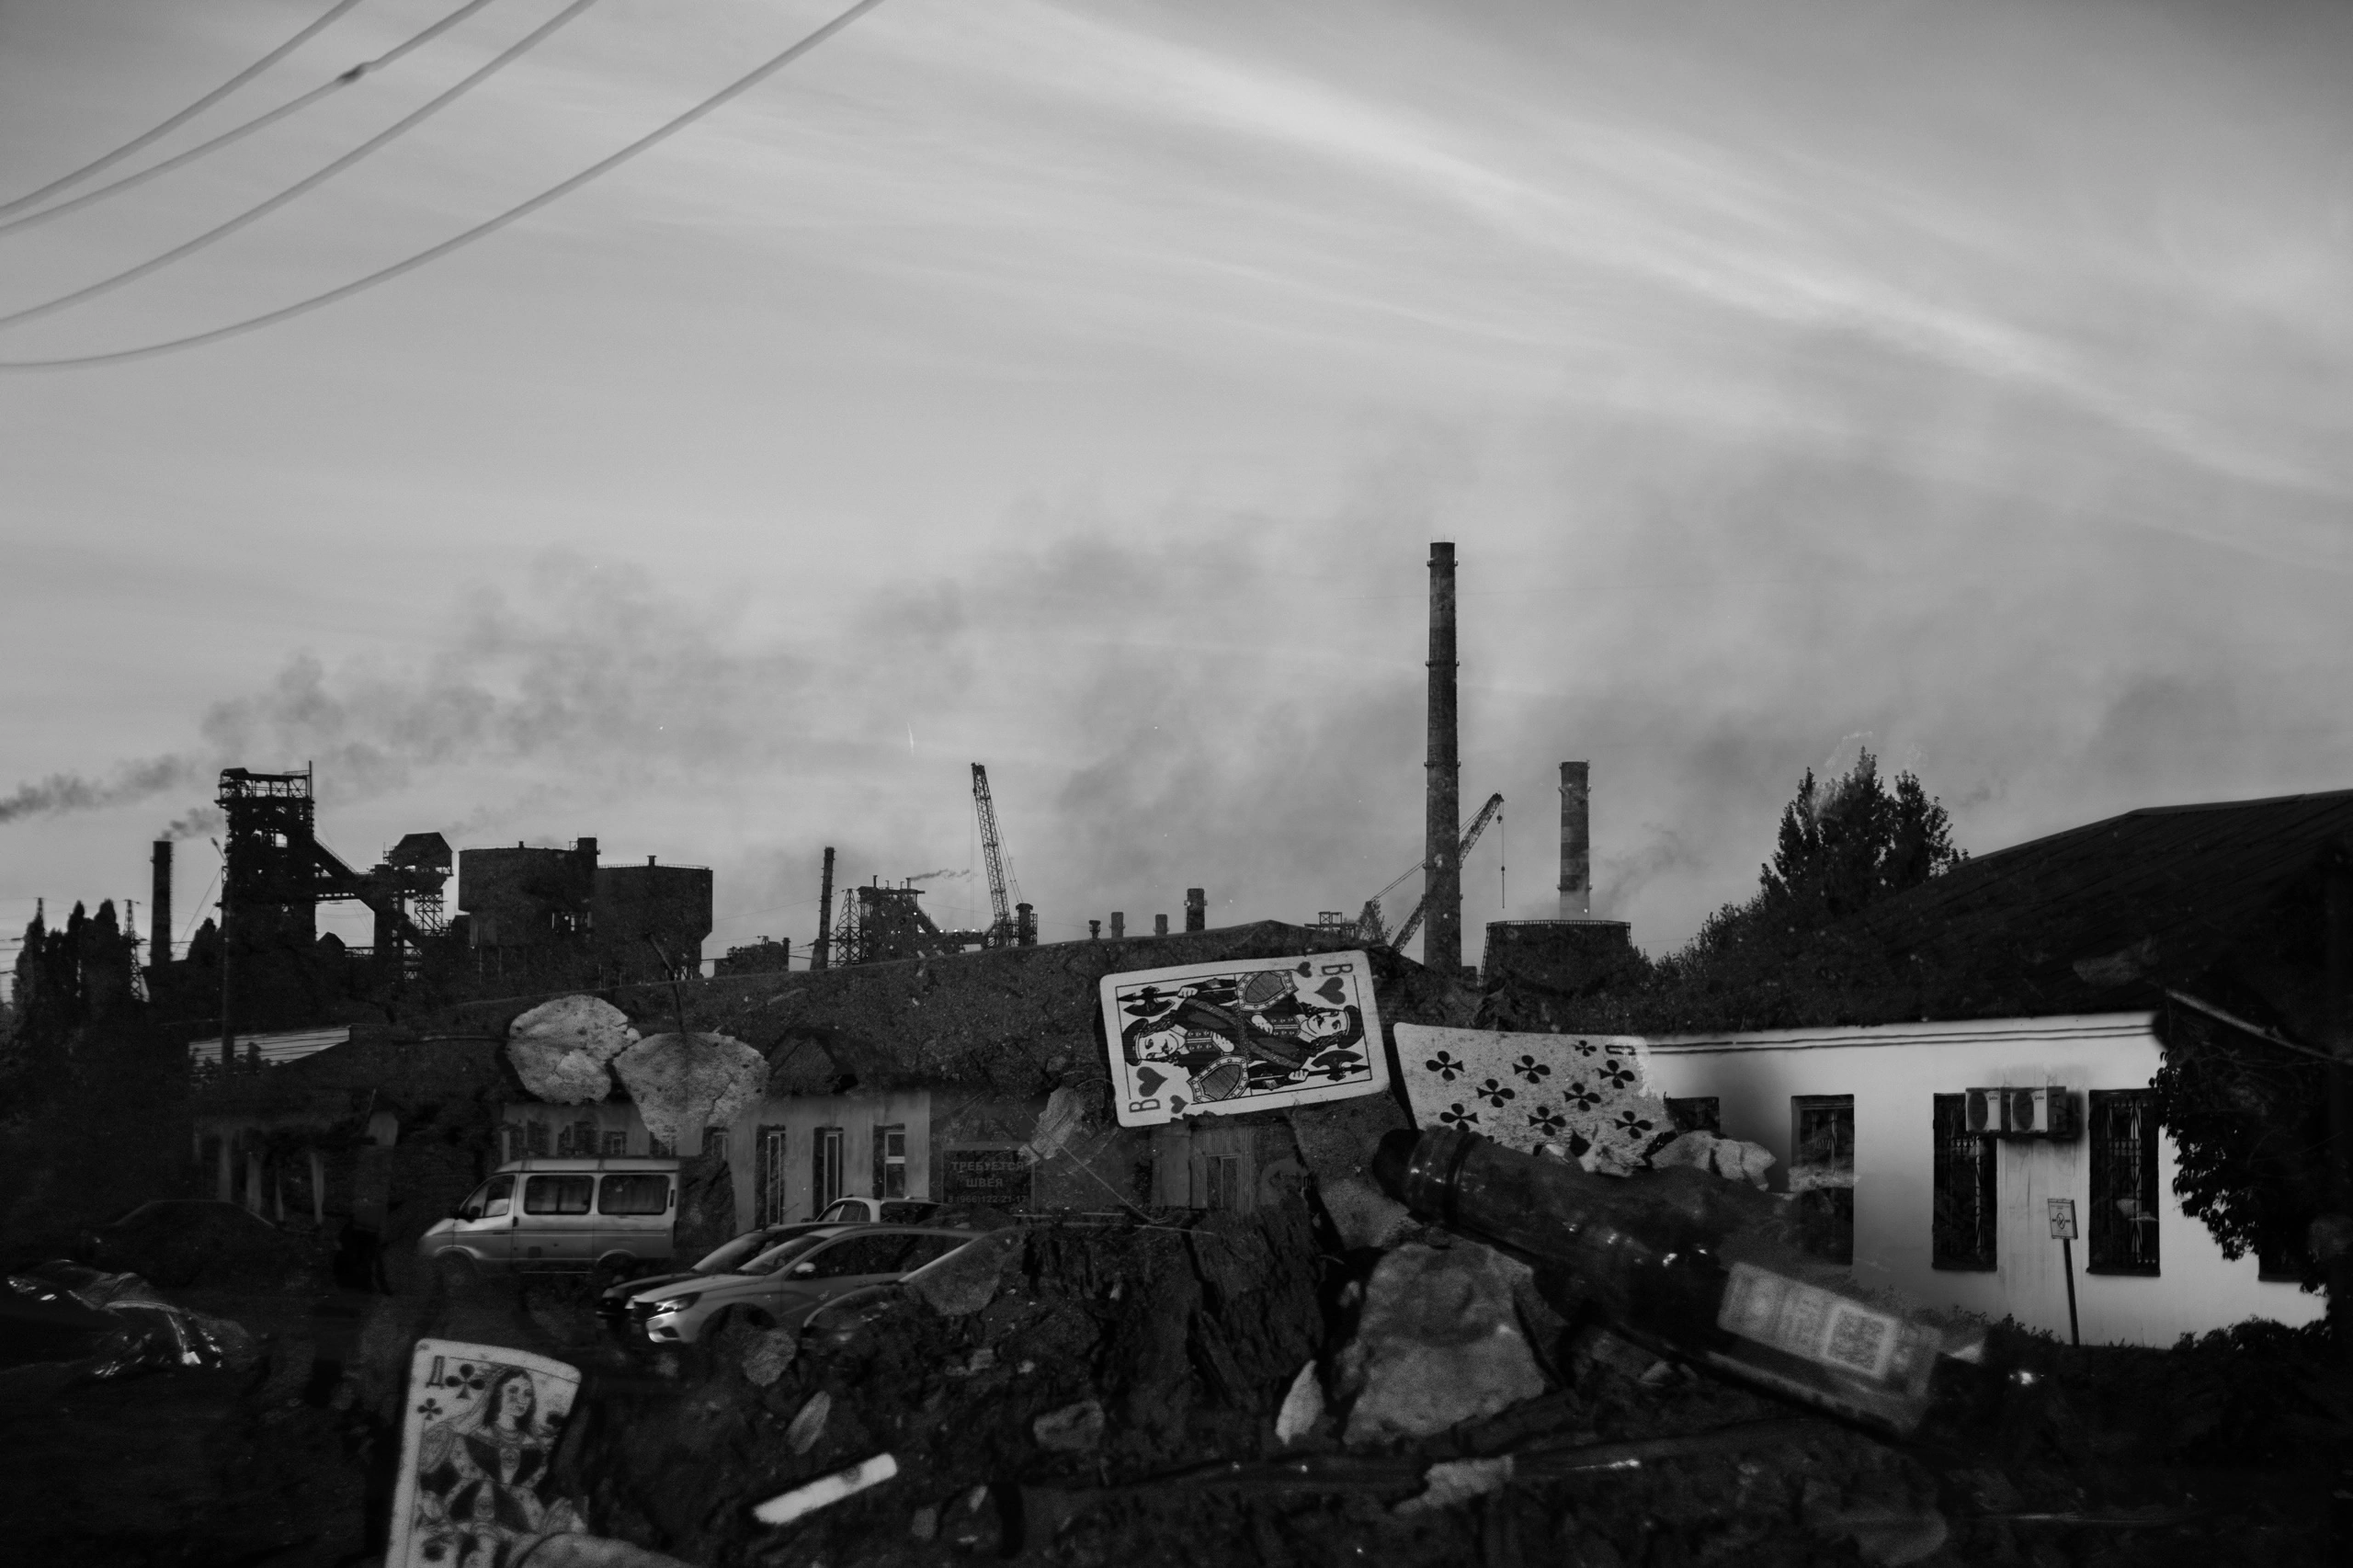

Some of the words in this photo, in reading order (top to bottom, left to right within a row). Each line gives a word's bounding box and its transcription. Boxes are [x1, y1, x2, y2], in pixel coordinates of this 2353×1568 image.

[951, 1161, 1024, 1171] ТРЕБУЕТСЯ
[966, 1177, 1003, 1187] ШВЕЯ
[426, 1355, 445, 1390] Д
